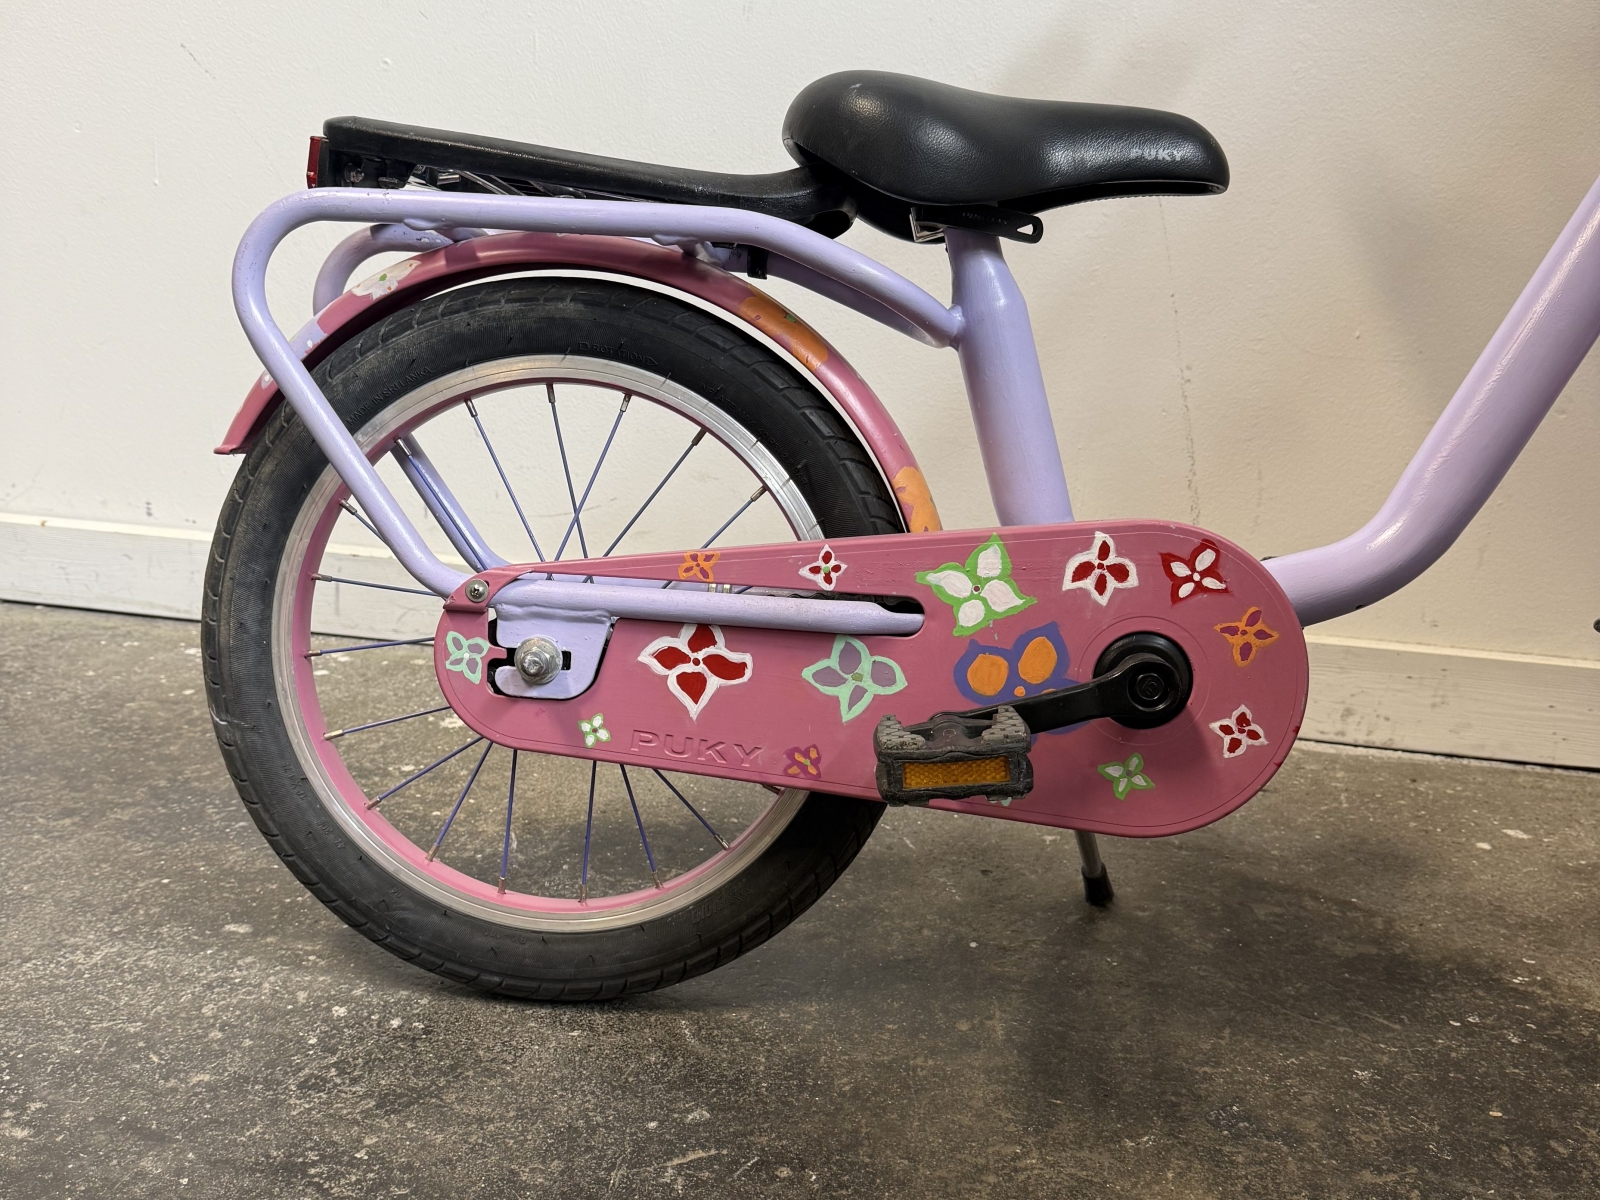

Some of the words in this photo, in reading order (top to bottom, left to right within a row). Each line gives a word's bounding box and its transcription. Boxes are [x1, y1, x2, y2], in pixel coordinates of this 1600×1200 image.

[345, 402, 374, 426] MADE
[370, 393, 384, 405] IN
[381, 381, 400, 398] SRI
[398, 366, 434, 387] LANKA
[630, 729, 764, 767] PUKY
